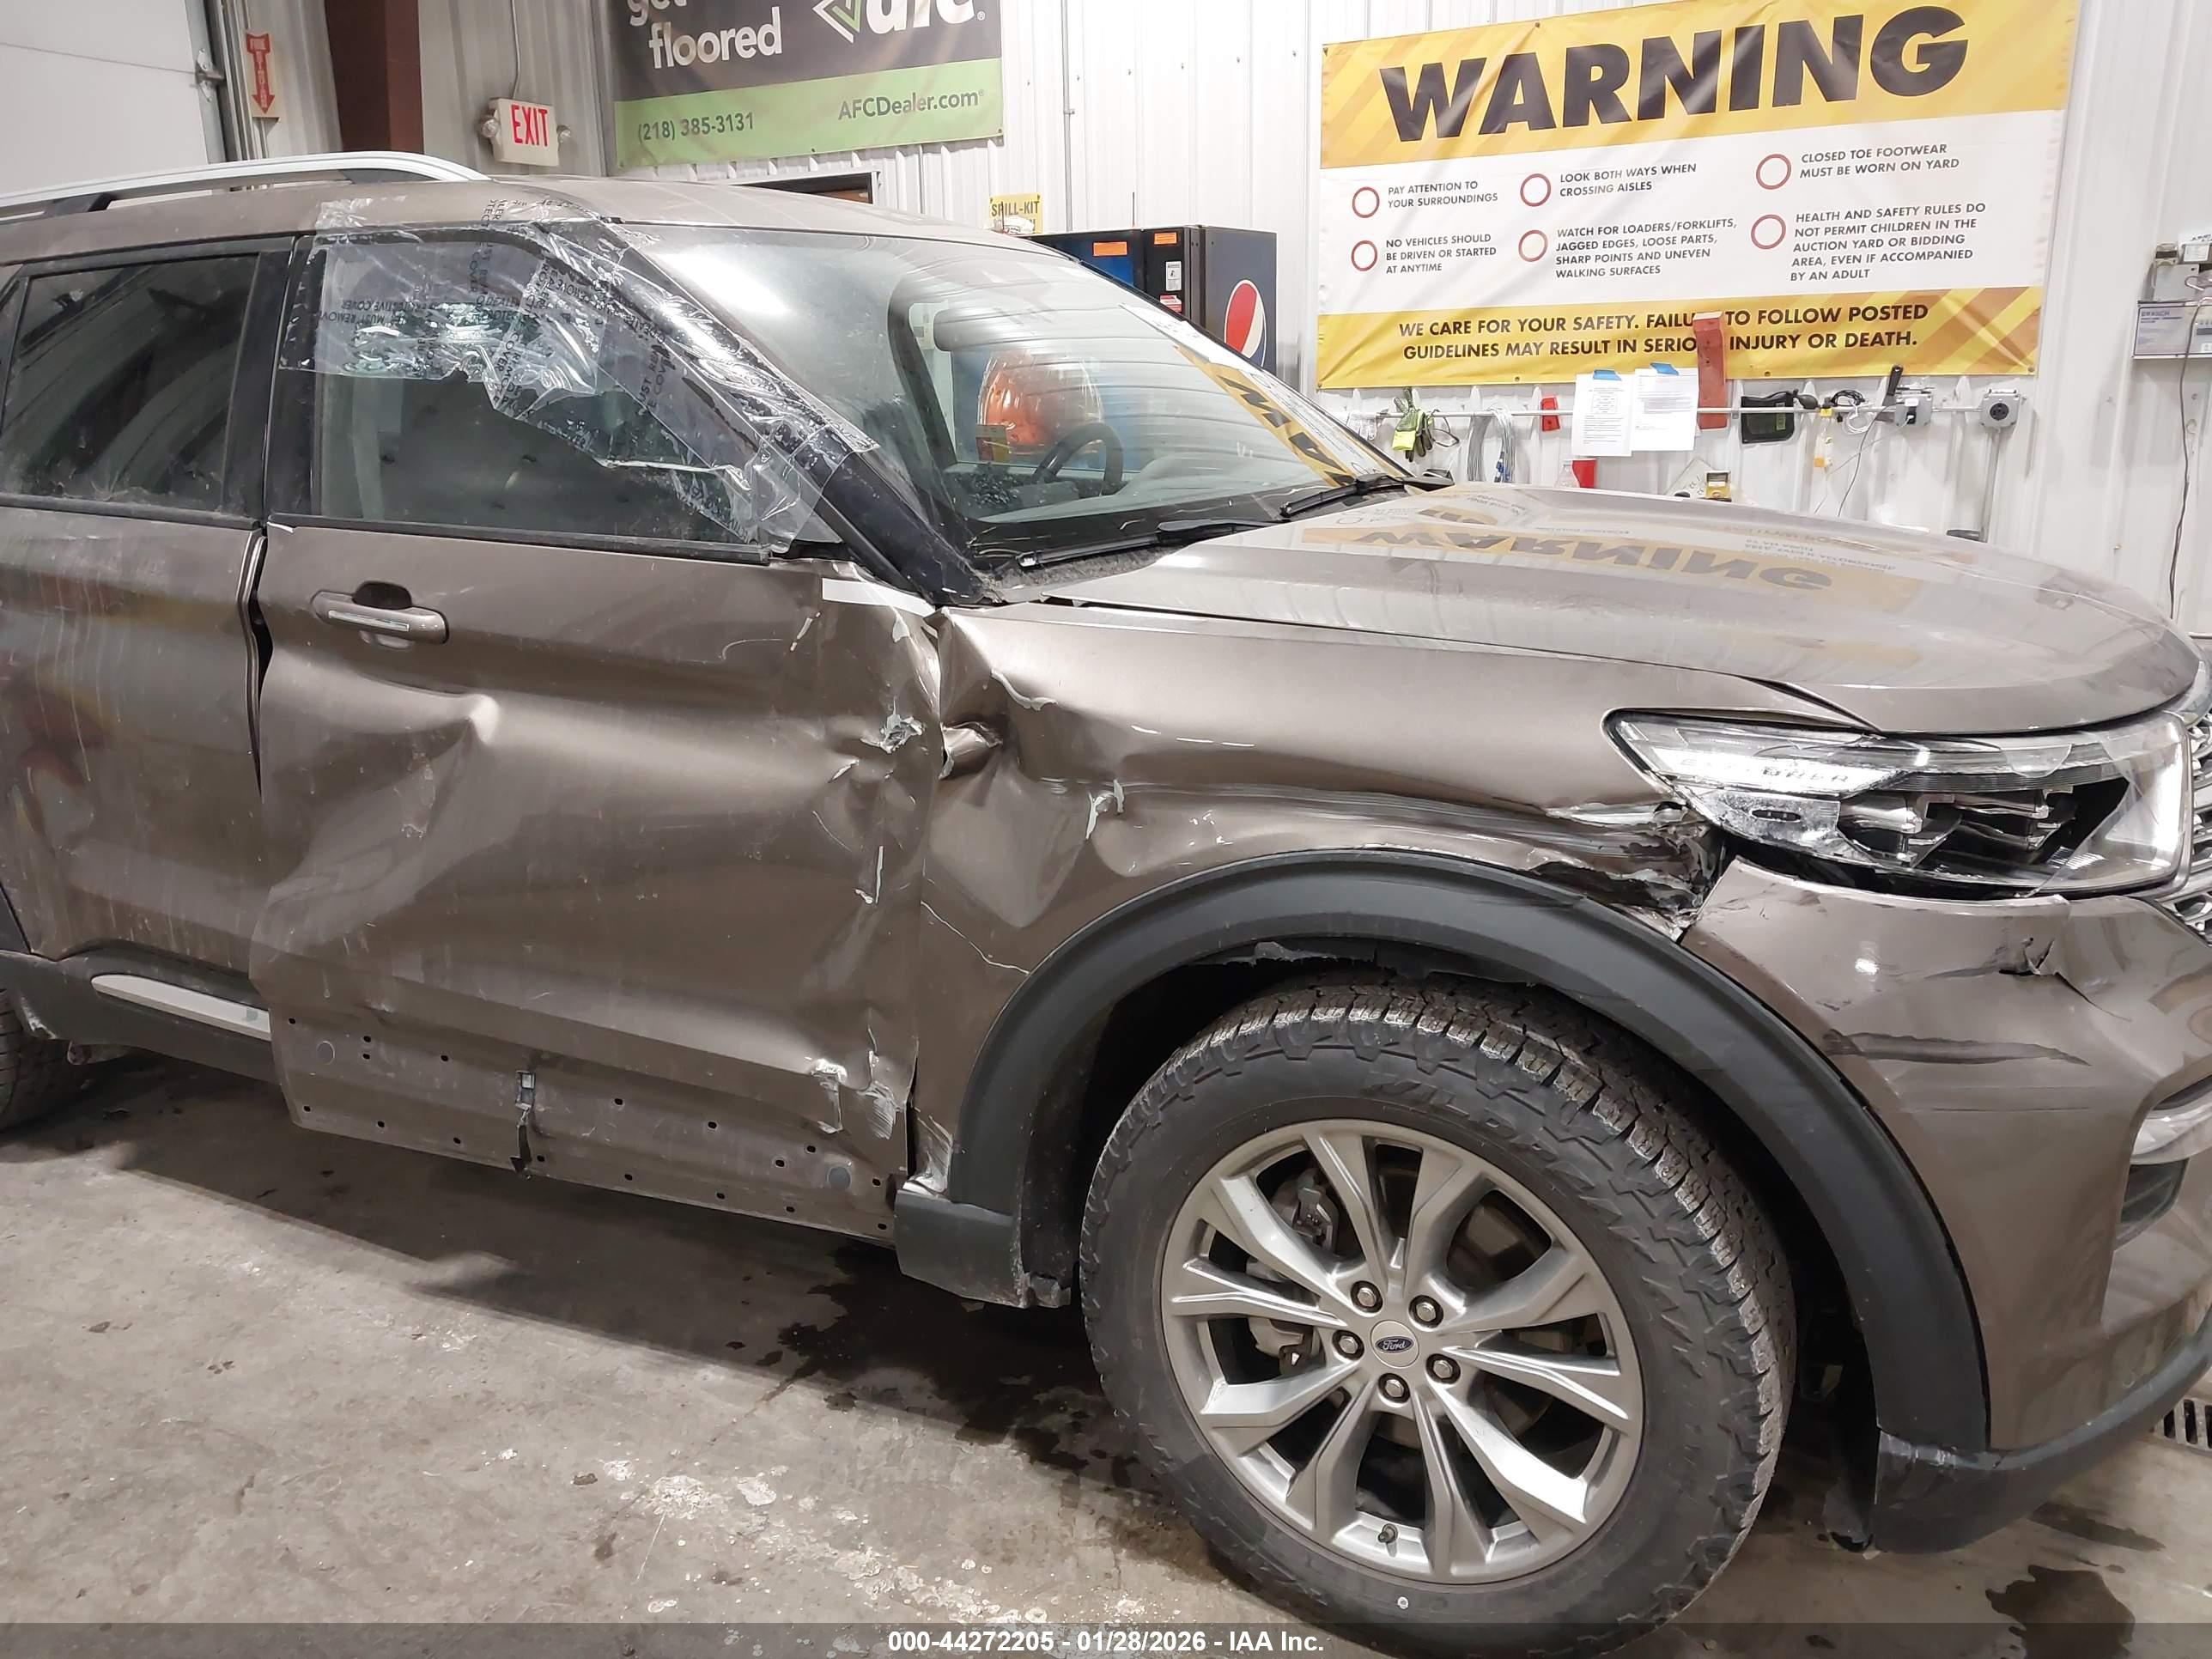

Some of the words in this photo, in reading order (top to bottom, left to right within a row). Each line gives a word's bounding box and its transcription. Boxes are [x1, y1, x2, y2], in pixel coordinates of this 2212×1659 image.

[648, 6, 782, 69] floored
[1379, 5, 1968, 143] WARNING
[511, 104, 548, 147] EXIT
[637, 118, 675, 142] (218)
[681, 112, 754, 137] 385-3131
[1802, 149, 1845, 163] CLOSED
[1850, 148, 1872, 160] TOE
[1876, 143, 1947, 157] FOOTWEAR
[1560, 172, 1590, 183] LOOK
[1594, 170, 1622, 181] BOTH
[1626, 166, 1656, 177] WAYS
[1660, 163, 1696, 174] WHEN
[1799, 166, 1832, 179] MUST
[1837, 164, 1850, 175] BE
[1854, 161, 1896, 174] WORN
[1899, 161, 1921, 171] ON
[1925, 158, 1960, 170] YARD
[1388, 185, 1405, 195] PAY
[1407, 182, 1462, 194] ATTENTION
[1465, 180, 1478, 190] TO
[1560, 183, 1614, 197] CROSSING
[1617, 181, 1652, 192] AISLES
[991, 200, 1040, 217] SPILL-KIT
[1388, 197, 1414, 208] YOUR
[1418, 192, 1498, 207] SURROUNDINGS
[1796, 210, 1840, 222] HEALTH
[1844, 209, 1872, 221] AND
[1876, 205, 1920, 218] SAFETY
[1924, 204, 1961, 216] RULES
[1966, 203, 1985, 214] DO
[1557, 226, 1594, 237] WATCH
[1597, 225, 1620, 235] FOR
[1623, 218, 1737, 234] LOADERS/FORKLIFTS,
[1795, 227, 1820, 238] NOT
[1823, 224, 1868, 236] PERMIT
[1870, 221, 1931, 234] CHILDREN
[1935, 220, 1949, 229] IN
[1953, 217, 1977, 229] THE
[1386, 239, 1402, 247] NO
[1406, 235, 1448, 246] VEHICLES
[1451, 234, 1492, 244] SHOULD
[1556, 240, 1598, 252] JAGGED
[1602, 237, 1638, 249] EDGES,
[1642, 235, 1677, 246] LOOSE
[1680, 234, 1717, 246] PARTS,
[1793, 240, 1848, 252] AUCTION
[1851, 238, 1885, 249] YARD
[1888, 237, 1906, 247] OR
[1910, 234, 1965, 246] BIDDING
[1386, 251, 1397, 261] BE
[1401, 249, 1436, 259] DRIVEN
[1439, 248, 1452, 258] OR
[1455, 246, 1497, 257] STARTED
[1556, 254, 1590, 265] SHARP
[1594, 252, 1632, 263] POINTS
[1637, 251, 1661, 261] AND
[1664, 248, 1711, 258] UNEVEN
[1792, 256, 1827, 267] AREA,
[1831, 254, 1863, 265] EVEN
[1866, 252, 1876, 263] IF
[1880, 249, 1973, 263] ACCOMPANIED
[1386, 264, 1397, 274] AT
[1401, 262, 1442, 273] ANYTIME
[1556, 267, 1606, 279] WALKING
[1609, 264, 1661, 276] SURFACES
[1790, 272, 1806, 282] BY
[1809, 270, 1828, 281] AN
[1832, 269, 1870, 280] ADULT
[1399, 322, 1424, 337] WE
[1429, 319, 1471, 336] CARE
[1477, 318, 1510, 333] FOR
[1517, 316, 1565, 332] YOUR
[1572, 314, 1638, 331] SAFETY.
[1646, 313, 1696, 328] FAILU
[1725, 309, 1751, 326] TO
[1758, 307, 1840, 325] FOLLOW
[1848, 304, 1928, 322] POSTED
[1403, 342, 1499, 360] GUIDELINES
[1505, 341, 1544, 356] MAY
[1549, 339, 1610, 356] RESULT
[1617, 338, 1636, 353] IN
[1644, 337, 1697, 353] SERIO
[1729, 333, 1800, 350] INJURY
[1808, 332, 1838, 349] OR
[1844, 331, 1917, 348] DEATH.
[1382, 1339, 1407, 1351] Ford
